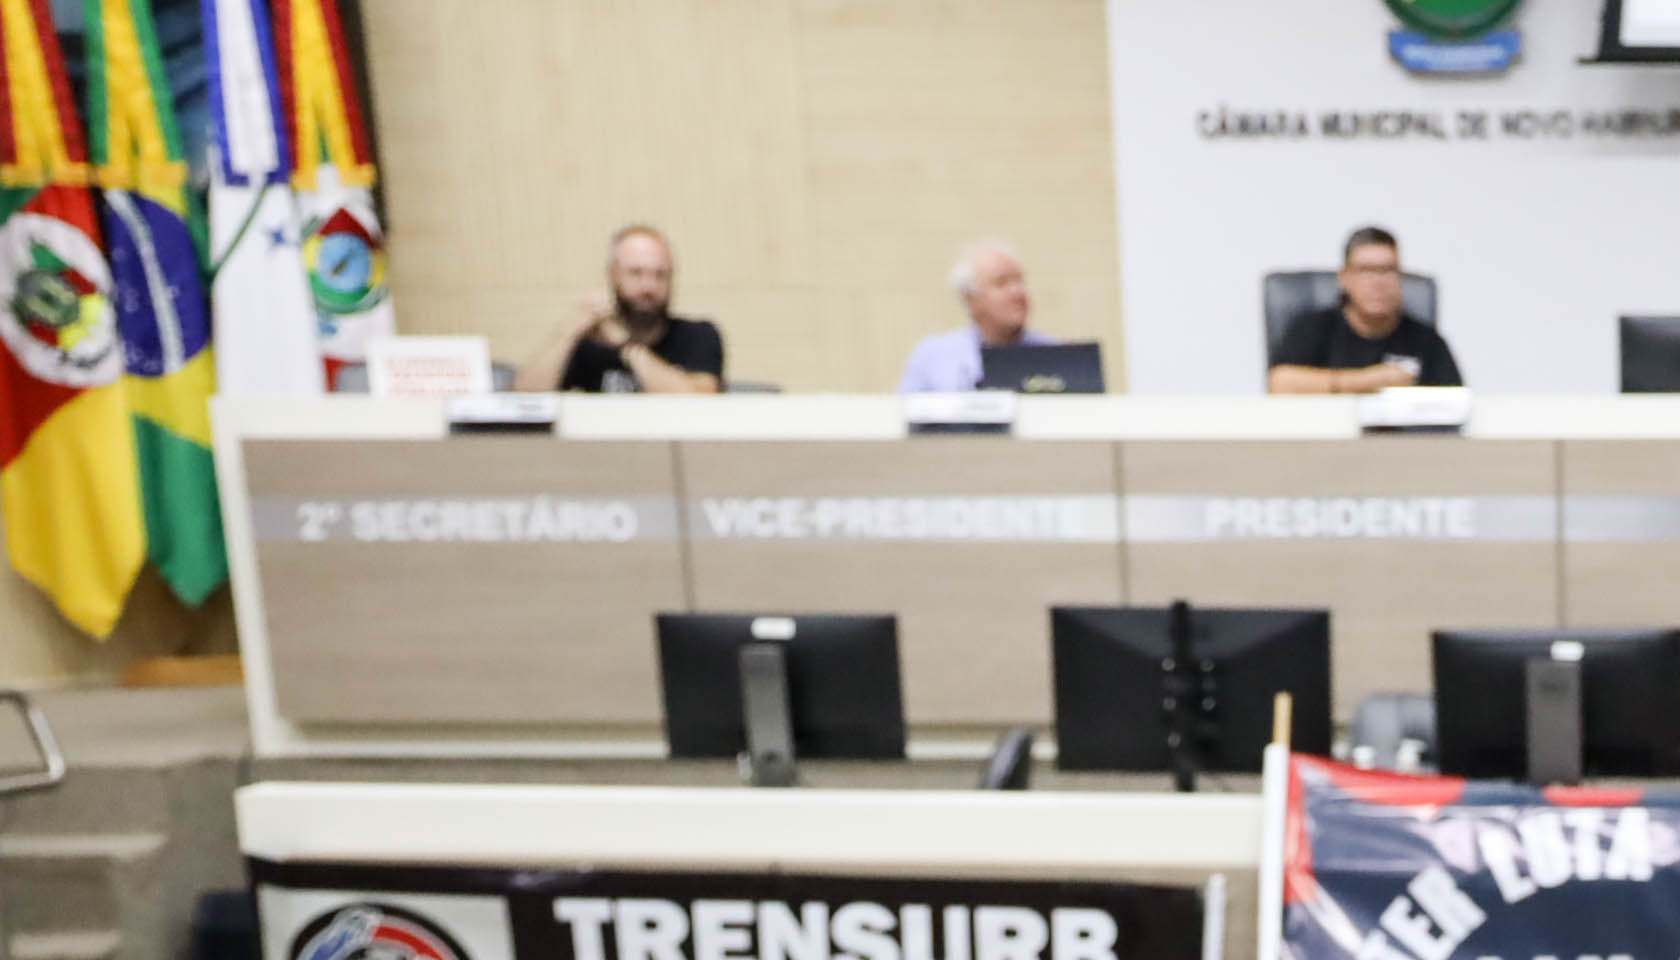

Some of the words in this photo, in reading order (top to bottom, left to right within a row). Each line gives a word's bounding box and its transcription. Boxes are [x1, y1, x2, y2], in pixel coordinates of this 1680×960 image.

[351, 494, 638, 542] SECRETÁRIO
[1204, 498, 1475, 538] PRESIDENTE
[1477, 806, 1654, 904] LUTA
